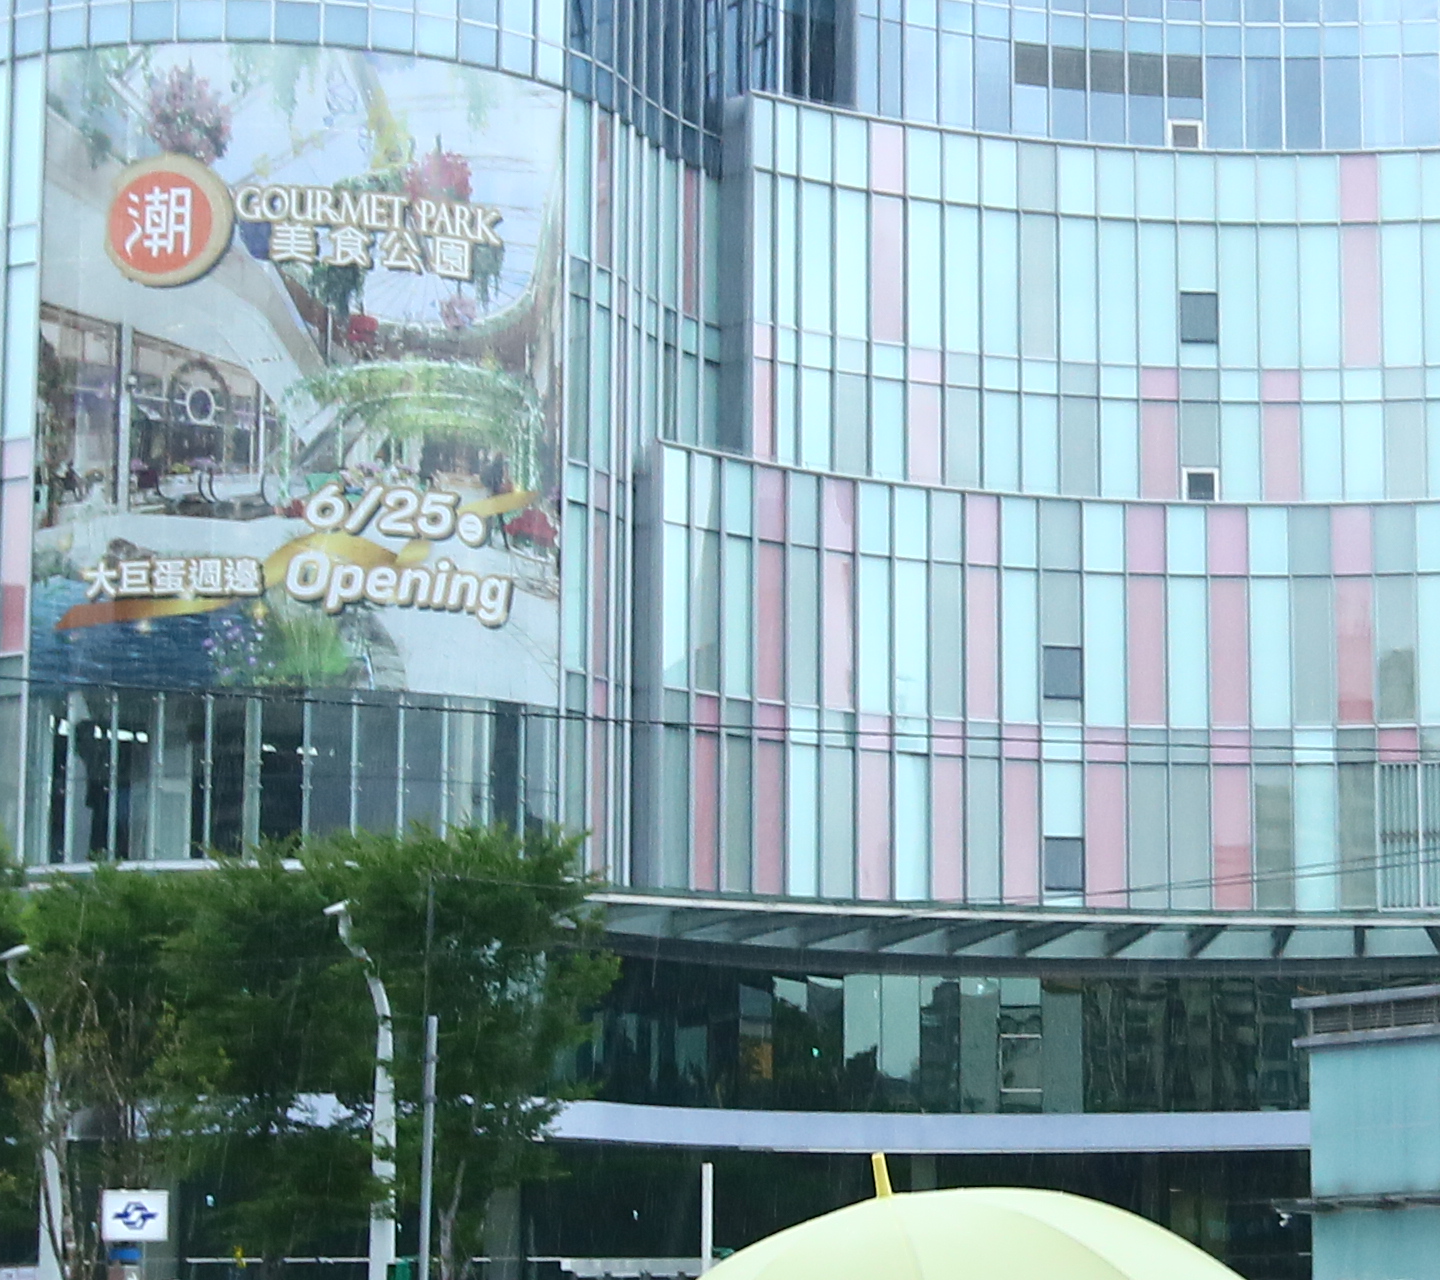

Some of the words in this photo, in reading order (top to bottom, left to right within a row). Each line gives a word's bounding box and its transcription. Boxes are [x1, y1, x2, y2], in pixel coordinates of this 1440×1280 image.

[124, 186, 192, 259] 潮
[236, 185, 409, 228] GOURMET
[413, 198, 503, 246] PARK
[271, 223, 472, 280] 美食公園
[305, 483, 456, 537] 6/25
[85, 558, 261, 599] 大巨蛋週邊
[285, 550, 510, 622] Opening
